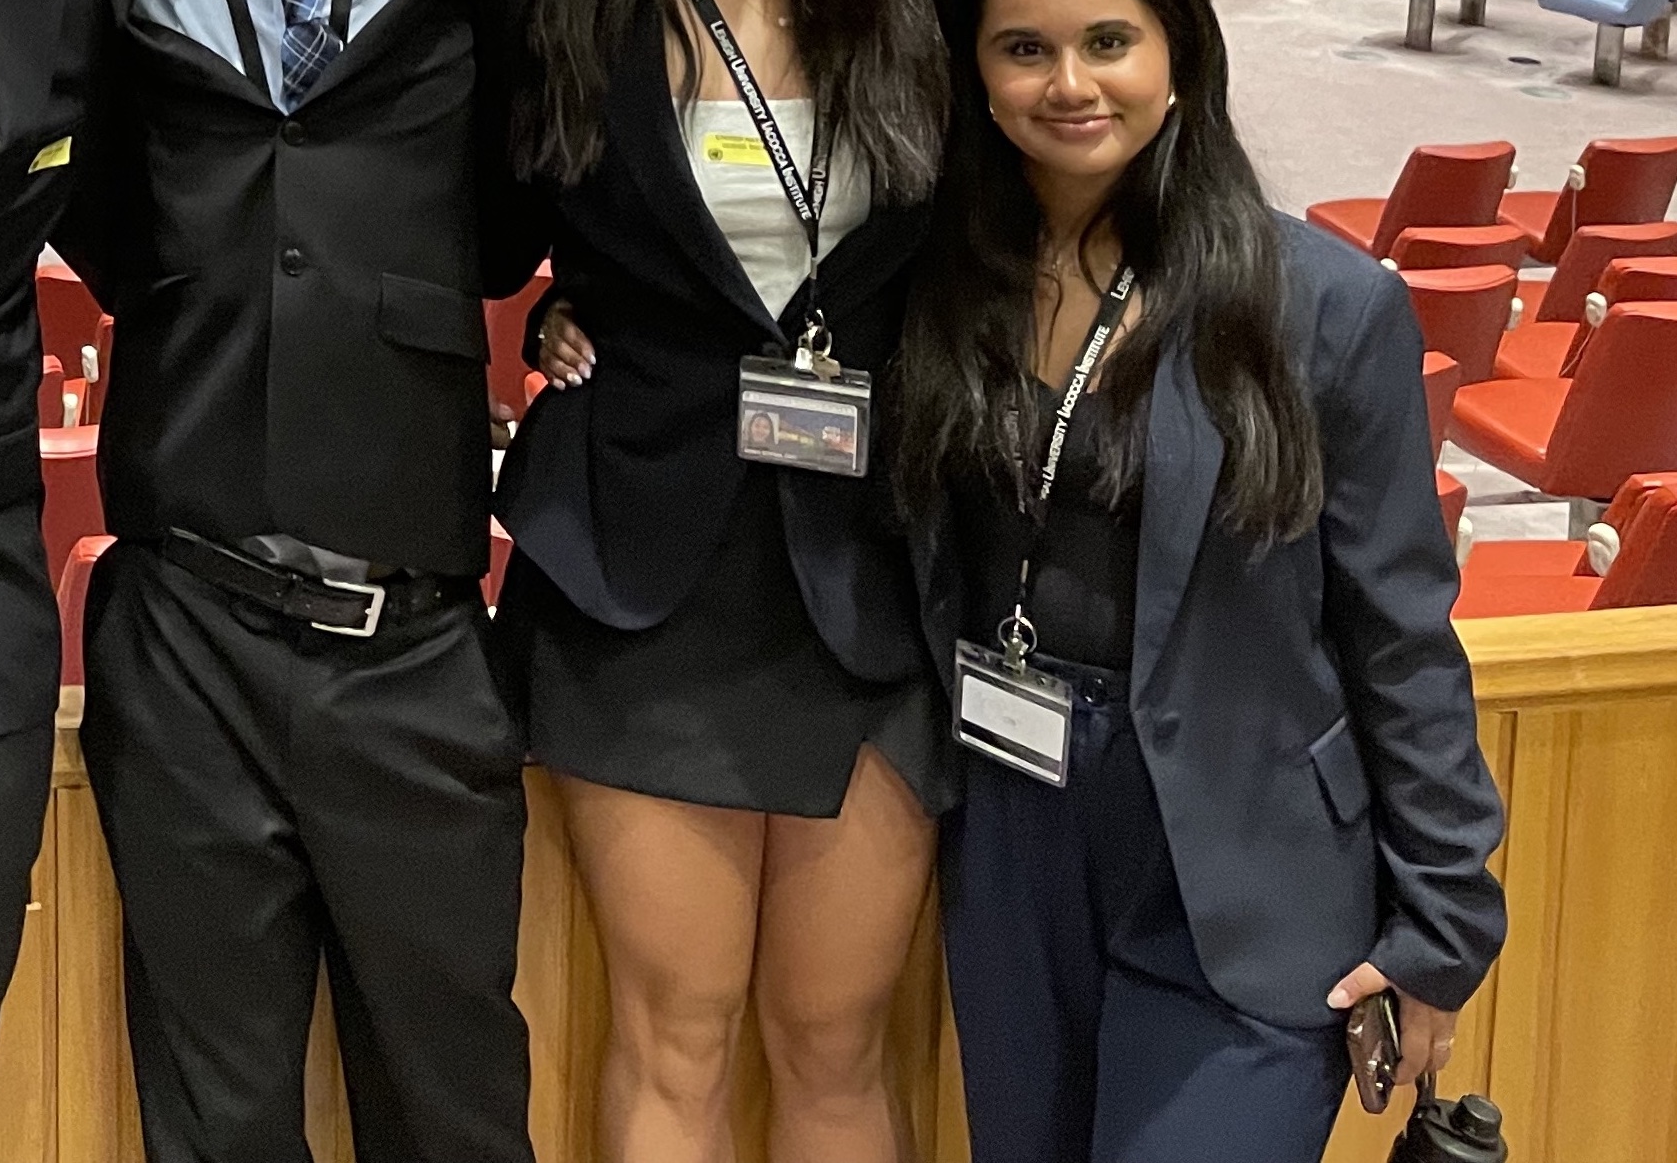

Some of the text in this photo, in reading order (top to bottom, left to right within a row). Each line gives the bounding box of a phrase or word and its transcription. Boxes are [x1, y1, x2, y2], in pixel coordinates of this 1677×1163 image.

[710, 20, 738, 61] LEHIGH
[731, 58, 767, 120] UNIVERSITY
[761, 120, 788, 169] IACOCCA
[782, 166, 812, 221] INSTITUTE
[1042, 417, 1068, 481] UNIVERSITY
[1057, 373, 1086, 419] IACOCCA
[1074, 324, 1110, 375] INSTITUTE
